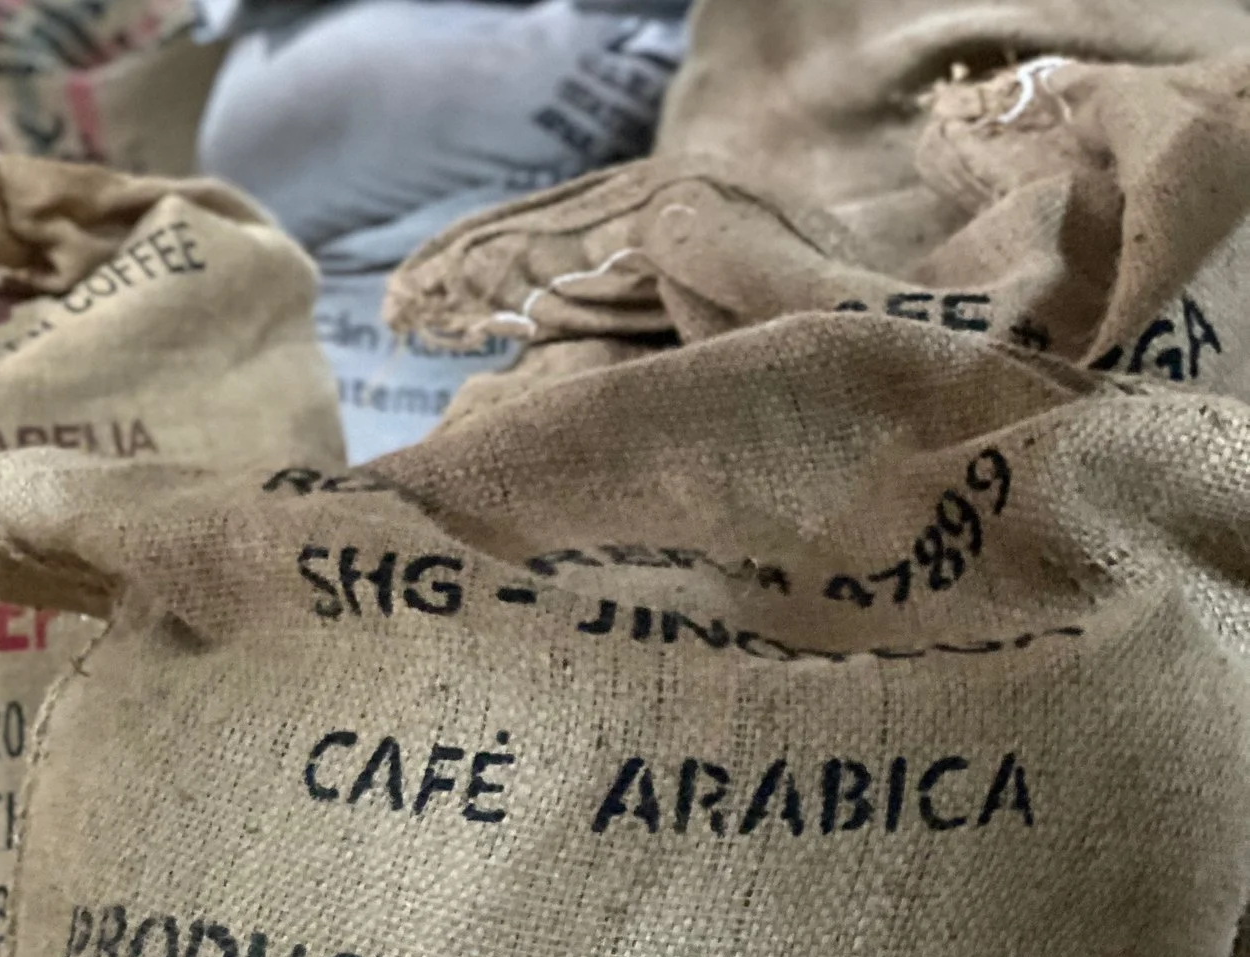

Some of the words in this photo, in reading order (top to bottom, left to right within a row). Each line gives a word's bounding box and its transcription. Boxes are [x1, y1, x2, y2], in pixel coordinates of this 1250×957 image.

[64, 222, 206, 314] COFFEE
[297, 544, 464, 620] SHG
[591, 751, 1035, 837] ARABICA
